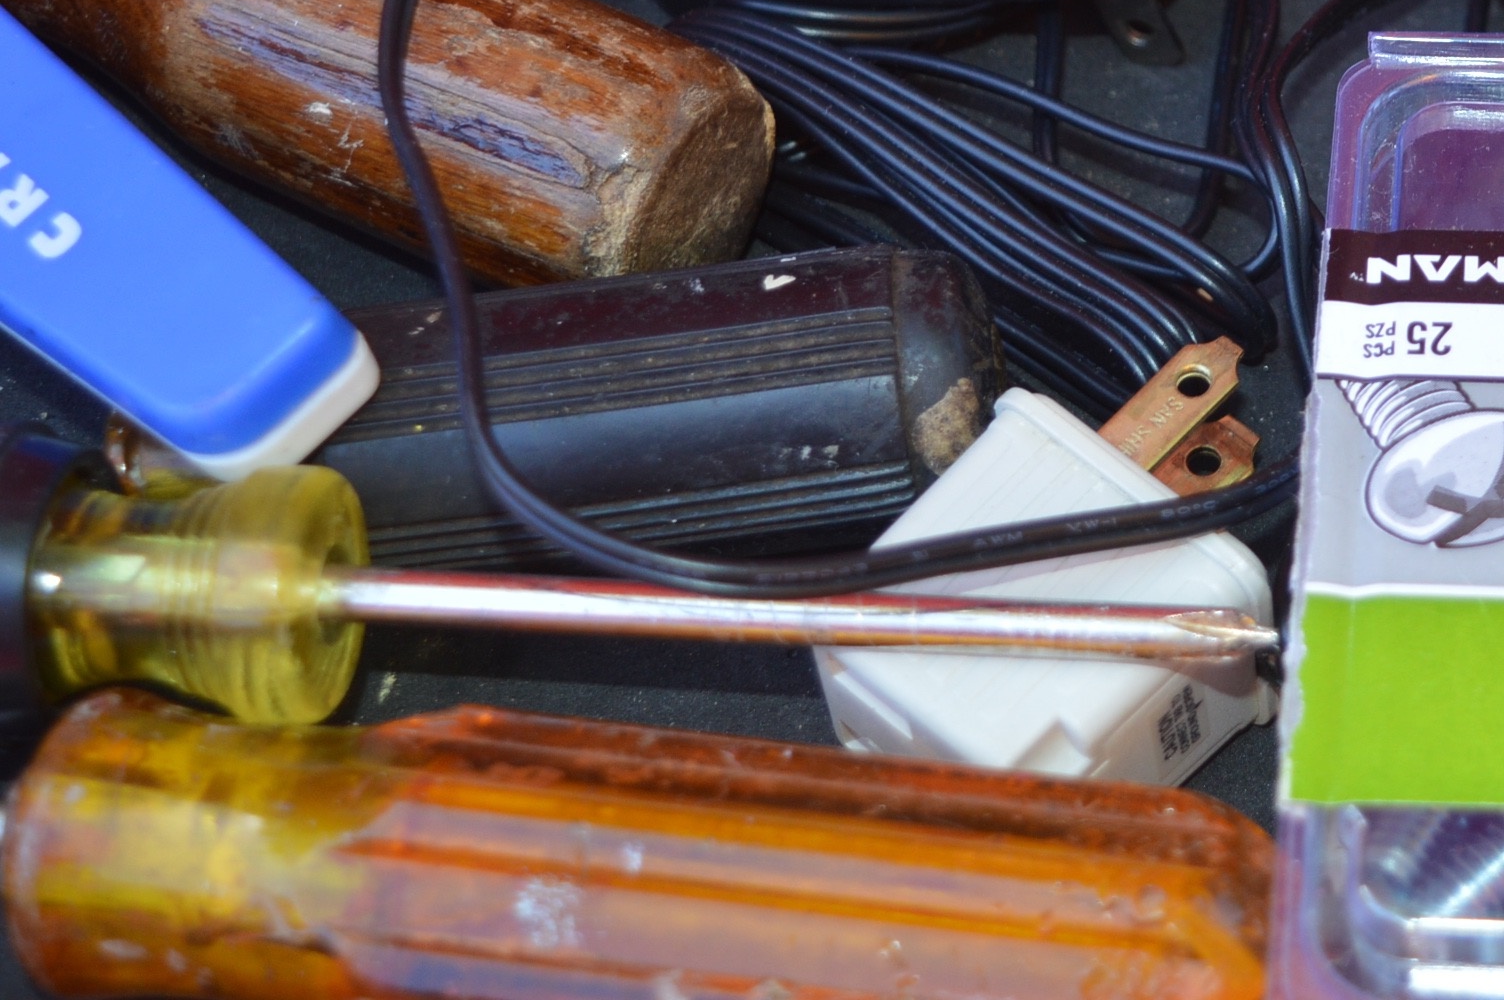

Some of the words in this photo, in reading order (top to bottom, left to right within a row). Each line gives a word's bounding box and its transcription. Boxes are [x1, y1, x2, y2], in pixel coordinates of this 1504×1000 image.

[0, 152, 82, 258] CR
[1365, 321, 1397, 338] PZS
[1406, 321, 1453, 356] 25
[1363, 341, 1395, 358] PCS
